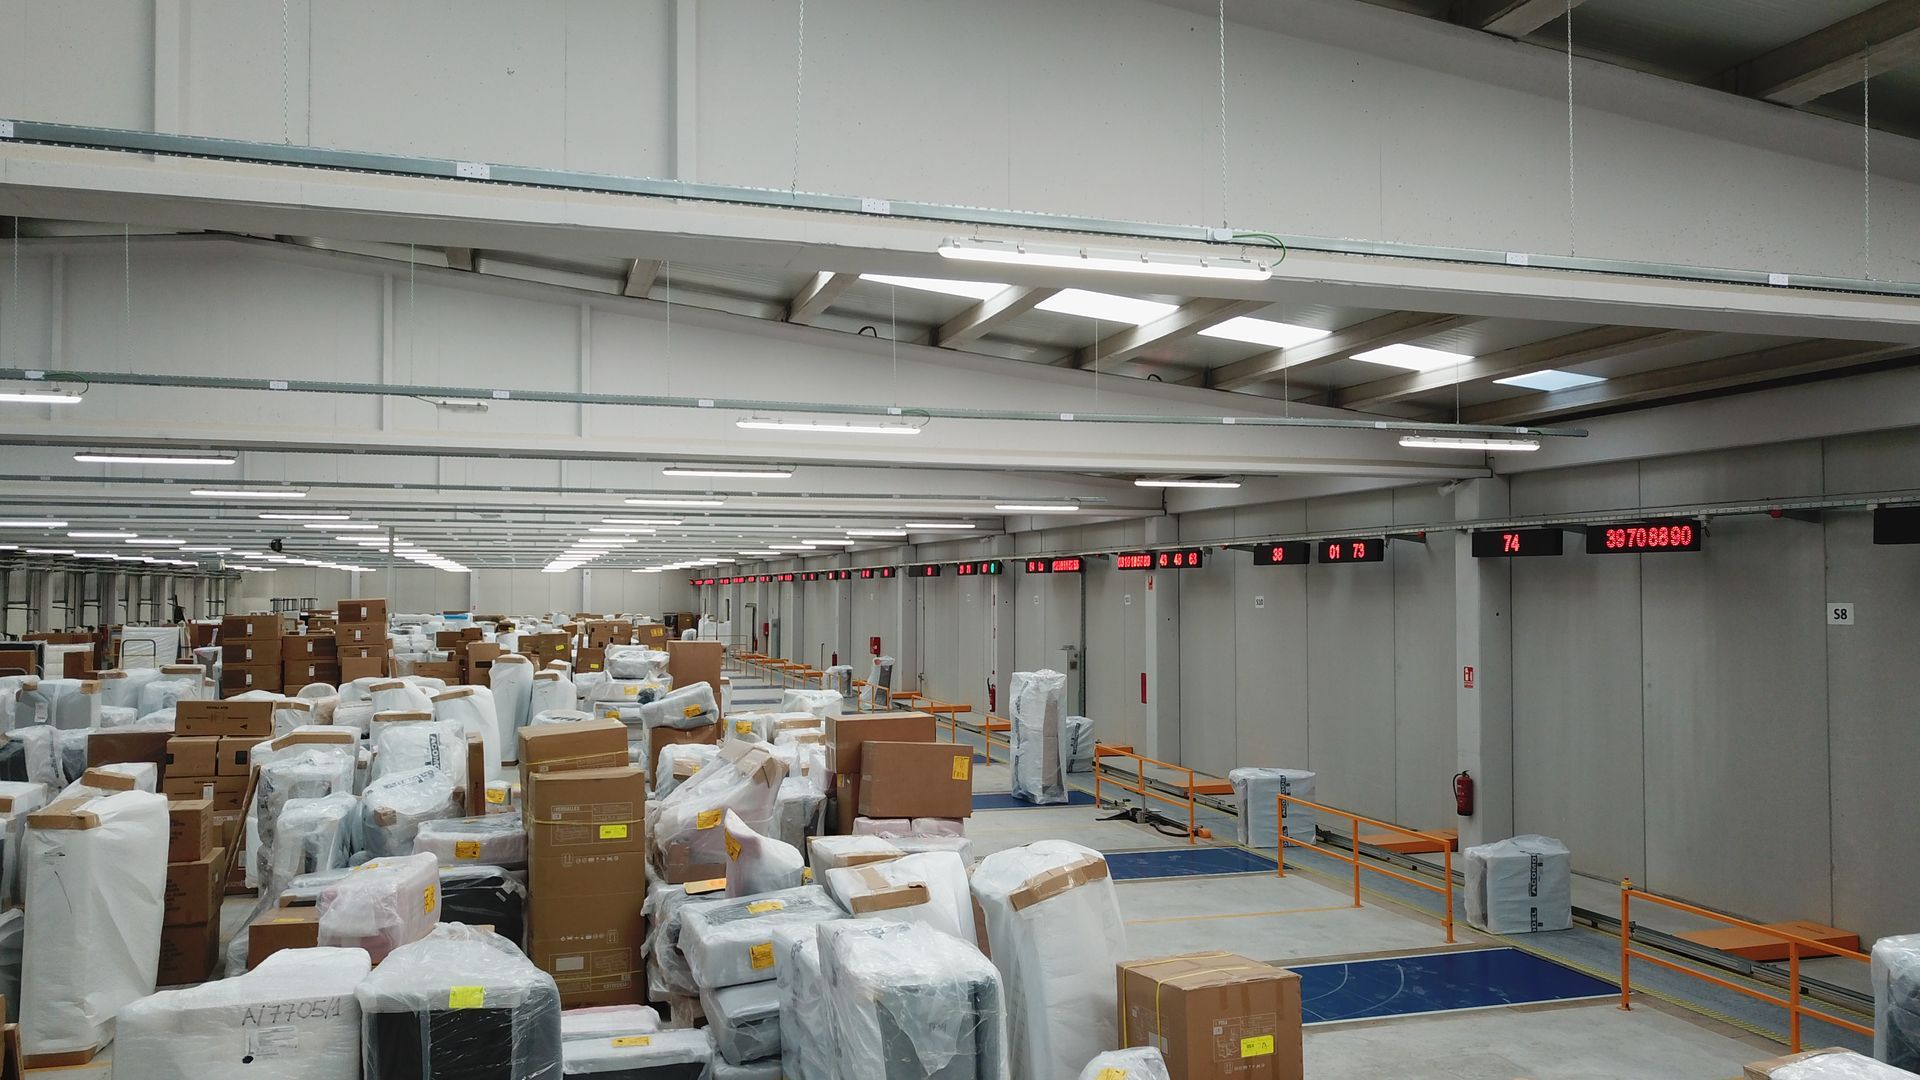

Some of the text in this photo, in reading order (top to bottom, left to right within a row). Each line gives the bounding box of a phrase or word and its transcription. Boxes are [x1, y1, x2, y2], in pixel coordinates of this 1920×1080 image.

[1329, 542, 1366, 560] 01 73
[1503, 533, 1521, 552] 74
[1833, 608, 1848, 620] S8
